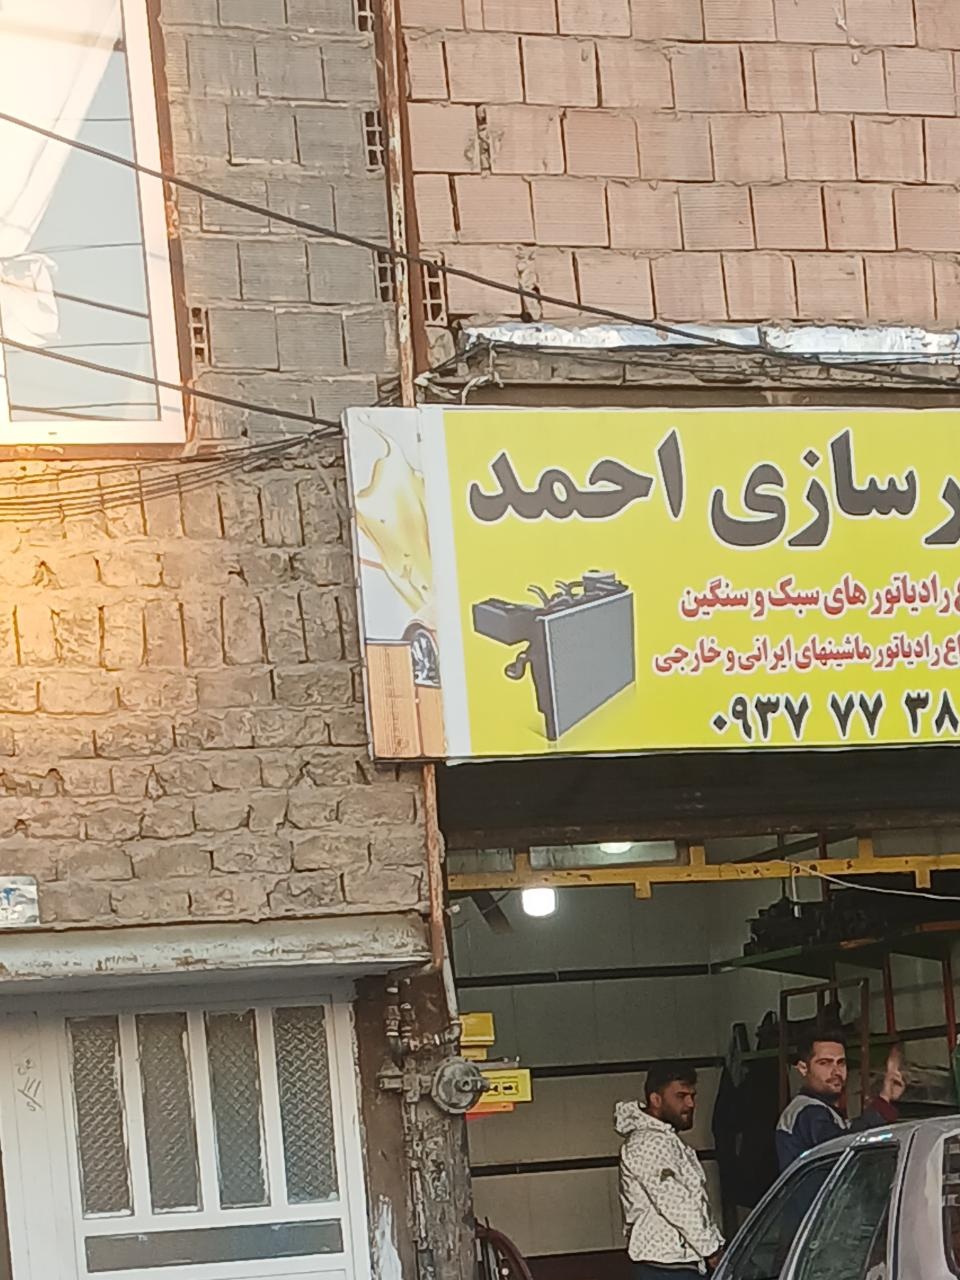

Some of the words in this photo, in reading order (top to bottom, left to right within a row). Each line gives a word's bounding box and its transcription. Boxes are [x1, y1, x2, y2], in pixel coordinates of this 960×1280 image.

[469, 429, 684, 521] احمد
[711, 429, 917, 548] سازی
[681, 578, 749, 618] سنگین
[753, 589, 765, 617] و
[768, 577, 820, 614] سبک
[824, 576, 867, 615] های
[870, 574, 950, 615] رادیاتور
[655, 637, 721, 673] خارجی
[725, 648, 735, 672] و
[738, 636, 792, 671] ایرانی
[795, 635, 872, 669] ماشینهای
[874, 633, 940, 668] رادیاتور
[713, 694, 809, 740] ۰۹۳۷
[830, 692, 884, 737] ۷۷
[904, 690, 959, 734] ۳۸
